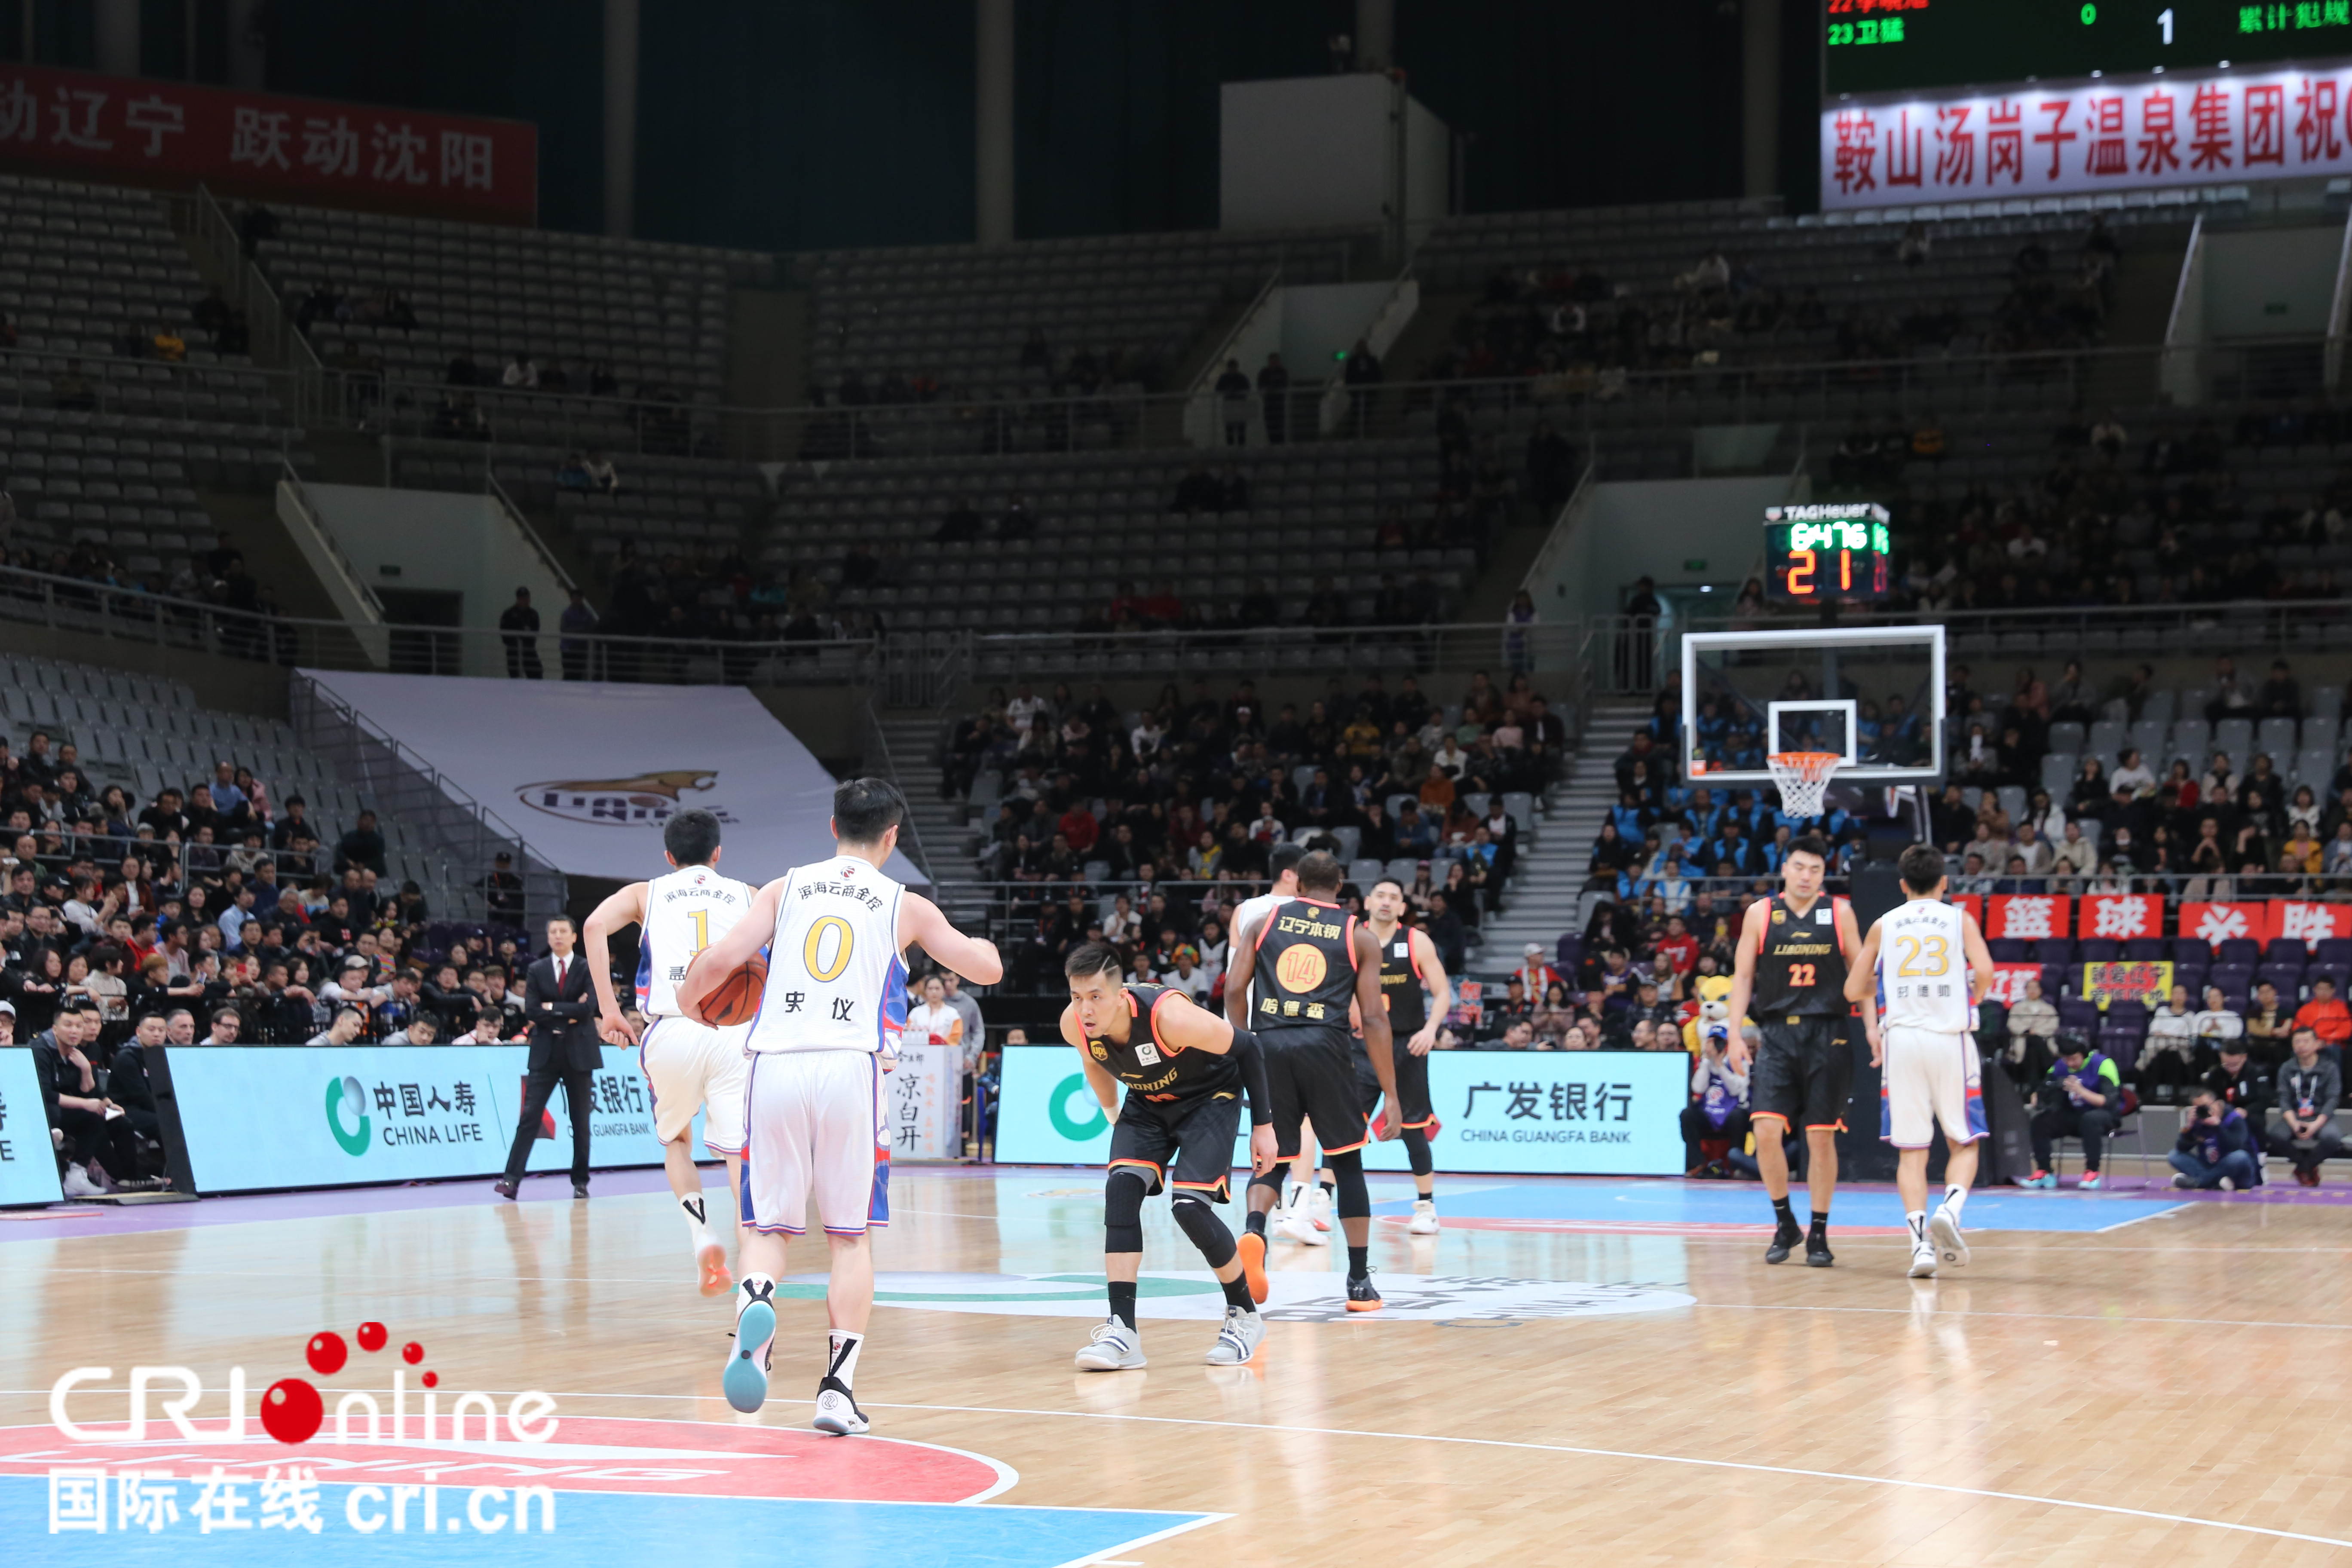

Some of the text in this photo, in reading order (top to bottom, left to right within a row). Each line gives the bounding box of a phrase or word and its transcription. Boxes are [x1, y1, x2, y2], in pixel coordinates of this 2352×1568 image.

[2081, 3, 2096, 25] 0
[2157, 8, 2173, 44] 1
[230, 107, 494, 191] 跃动沈阳
[798, 881, 883, 912] 滨海云商金控
[688, 908, 709, 957] 1
[1277, 916, 1342, 940] 辽宁本钢
[803, 915, 854, 983] 0
[1896, 934, 1949, 977] 23
[1286, 952, 1317, 984] 14
[1788, 963, 1816, 987] 22
[1260, 997, 1325, 1020] 哈德森
[373, 1080, 476, 1121] 中国人寿
[1464, 1081, 1632, 1121] 广发银行
[383, 1123, 484, 1146] CHINA LIFE
[593, 1124, 630, 1137] GUANGFA
[630, 1122, 652, 1136] BANK
[1461, 1129, 1632, 1144] CHINA GUANGFA BANK
